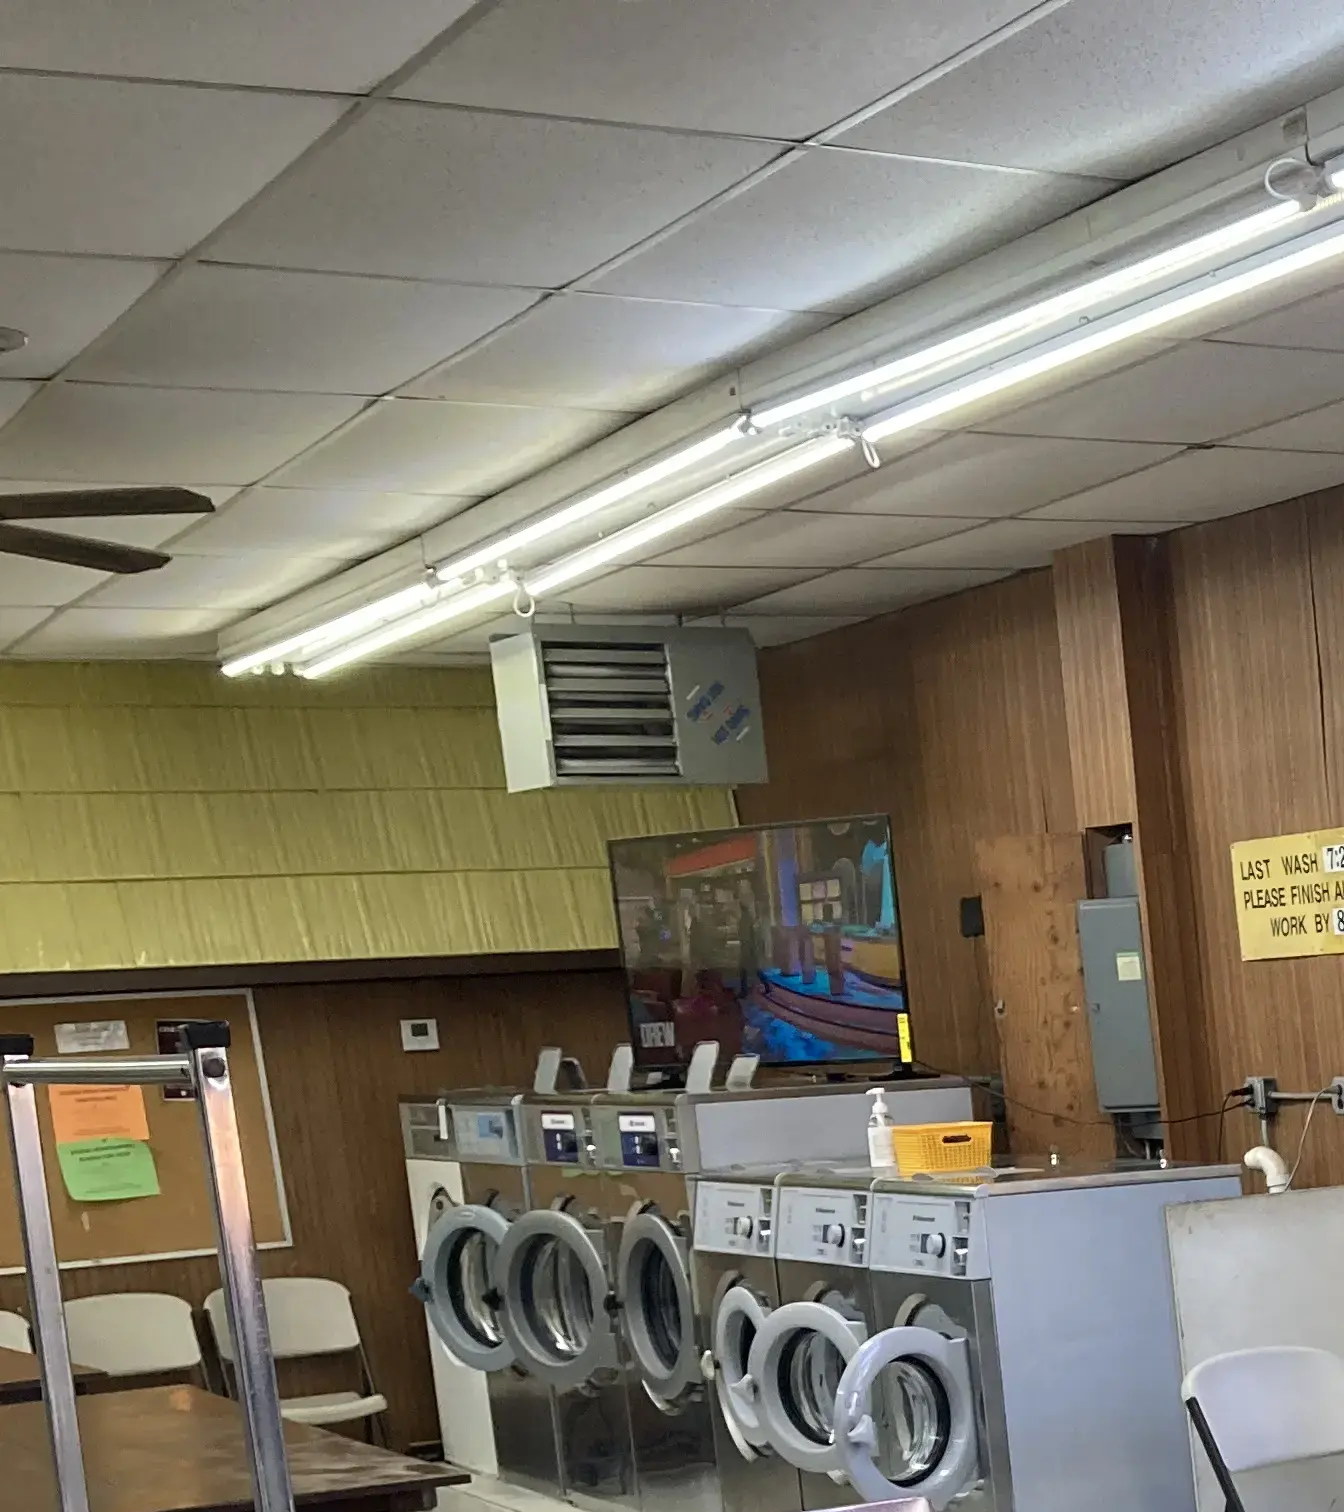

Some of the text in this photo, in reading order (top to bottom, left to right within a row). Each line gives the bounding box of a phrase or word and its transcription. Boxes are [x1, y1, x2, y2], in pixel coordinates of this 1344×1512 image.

[1240, 859, 1271, 881] LAST
[1281, 852, 1318, 876] WASH
[1243, 886, 1286, 910] PLEASE
[1290, 882, 1330, 905] FINISH
[1270, 914, 1308, 938] WORK
[1315, 912, 1330, 934] BY
[640, 1021, 675, 1048] DREW
